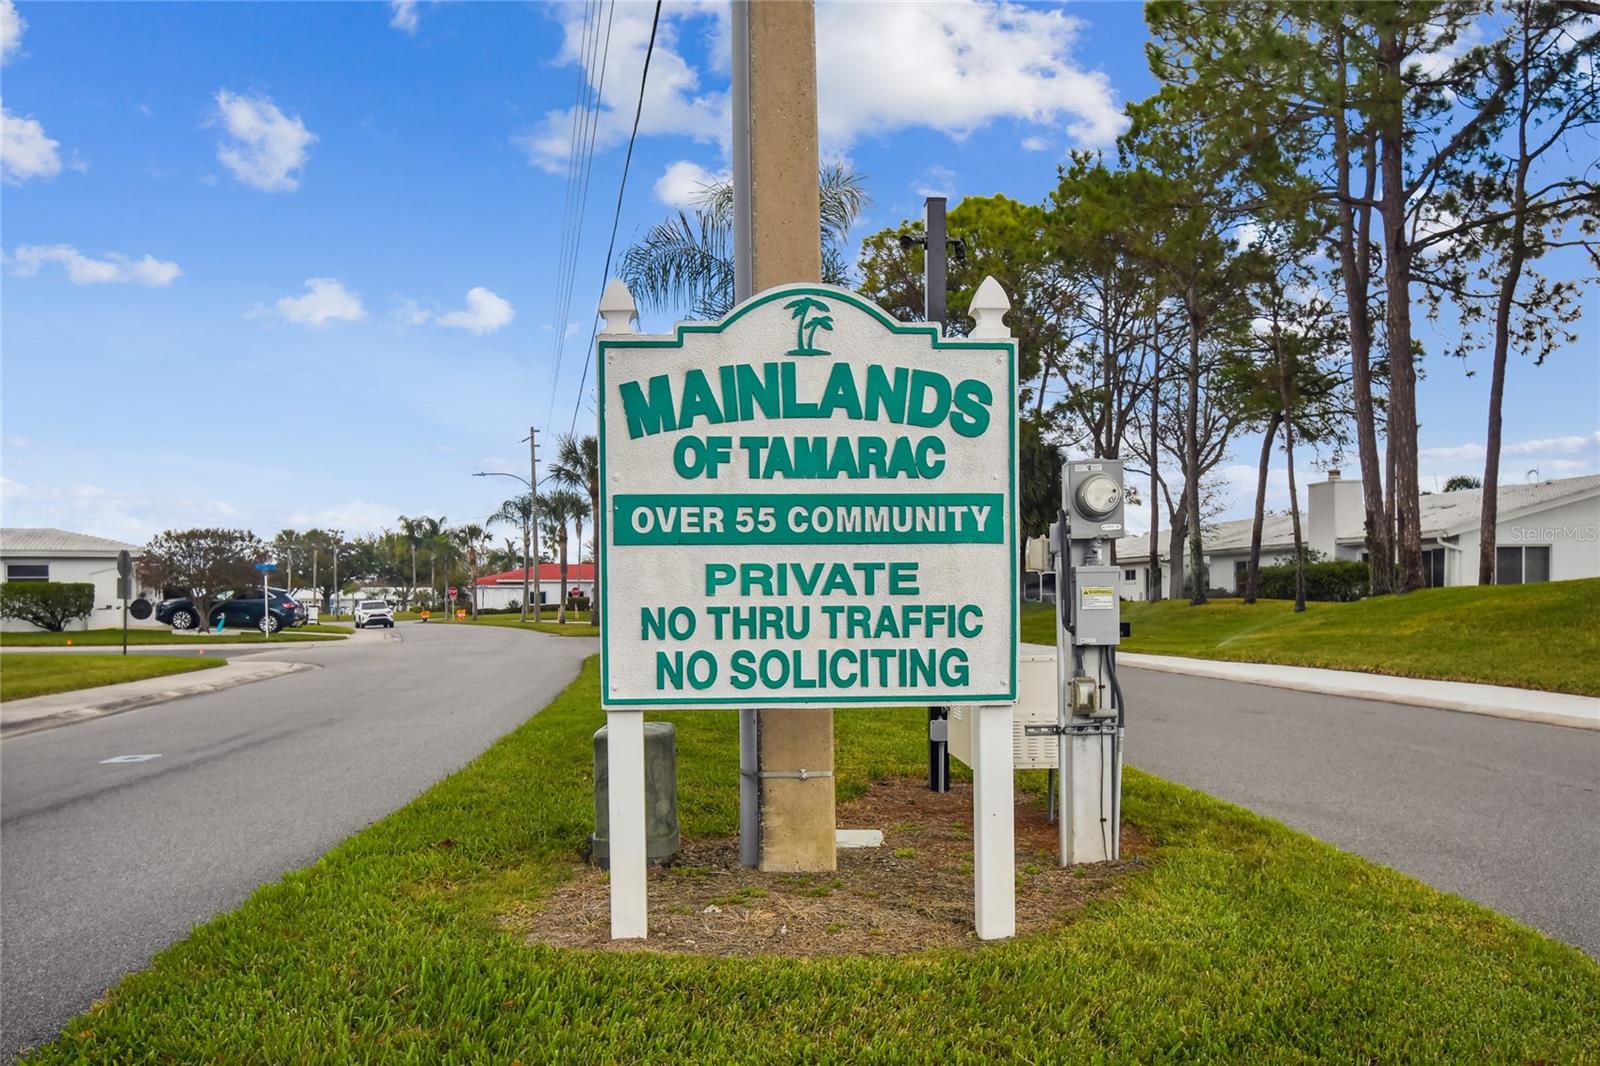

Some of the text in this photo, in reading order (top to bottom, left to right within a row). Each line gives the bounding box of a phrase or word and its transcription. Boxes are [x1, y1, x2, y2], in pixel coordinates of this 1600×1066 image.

[619, 362, 993, 440] MAINLANDS
[674, 435, 945, 480] OF TAMARAC
[631, 506, 991, 533] OVER 55 COMMUNITY
[705, 562, 919, 596] PRIVATE
[642, 604, 983, 640] NO THRU TRAFFIC
[657, 648, 969, 689] NO SOLICITING
